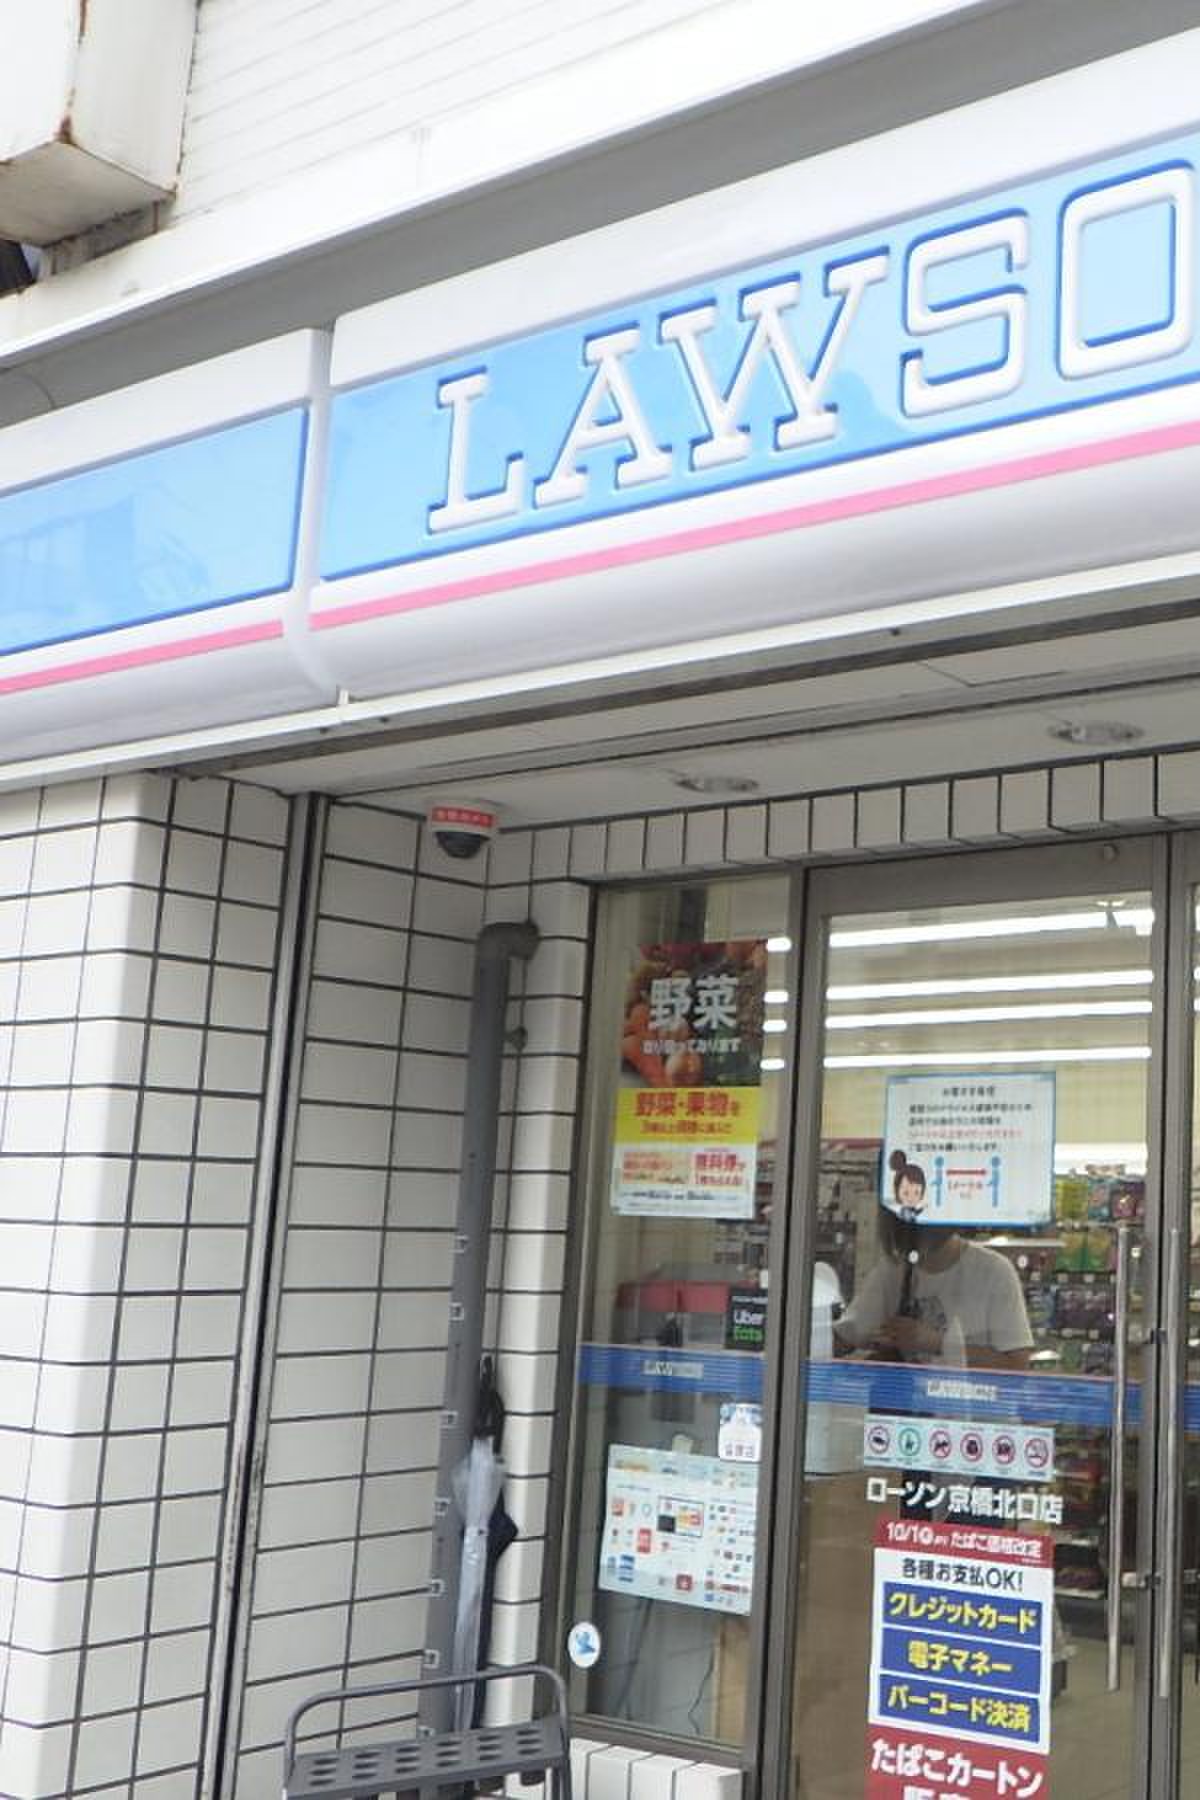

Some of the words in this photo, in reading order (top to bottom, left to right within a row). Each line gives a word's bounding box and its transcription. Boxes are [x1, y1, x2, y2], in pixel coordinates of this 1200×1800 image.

[649, 973, 739, 1031] 野菜
[734, 1309, 764, 1326] Uber
[866, 1476, 1065, 1525] ローソン京橋北口店
[902, 1557, 1024, 1592] 各種お支払OK!
[889, 1592, 1037, 1634] クレジットカード
[907, 1639, 1013, 1677] 電子マネー
[887, 1684, 1032, 1732] バーコード決済
[870, 1737, 1044, 1798] たばこカートン
